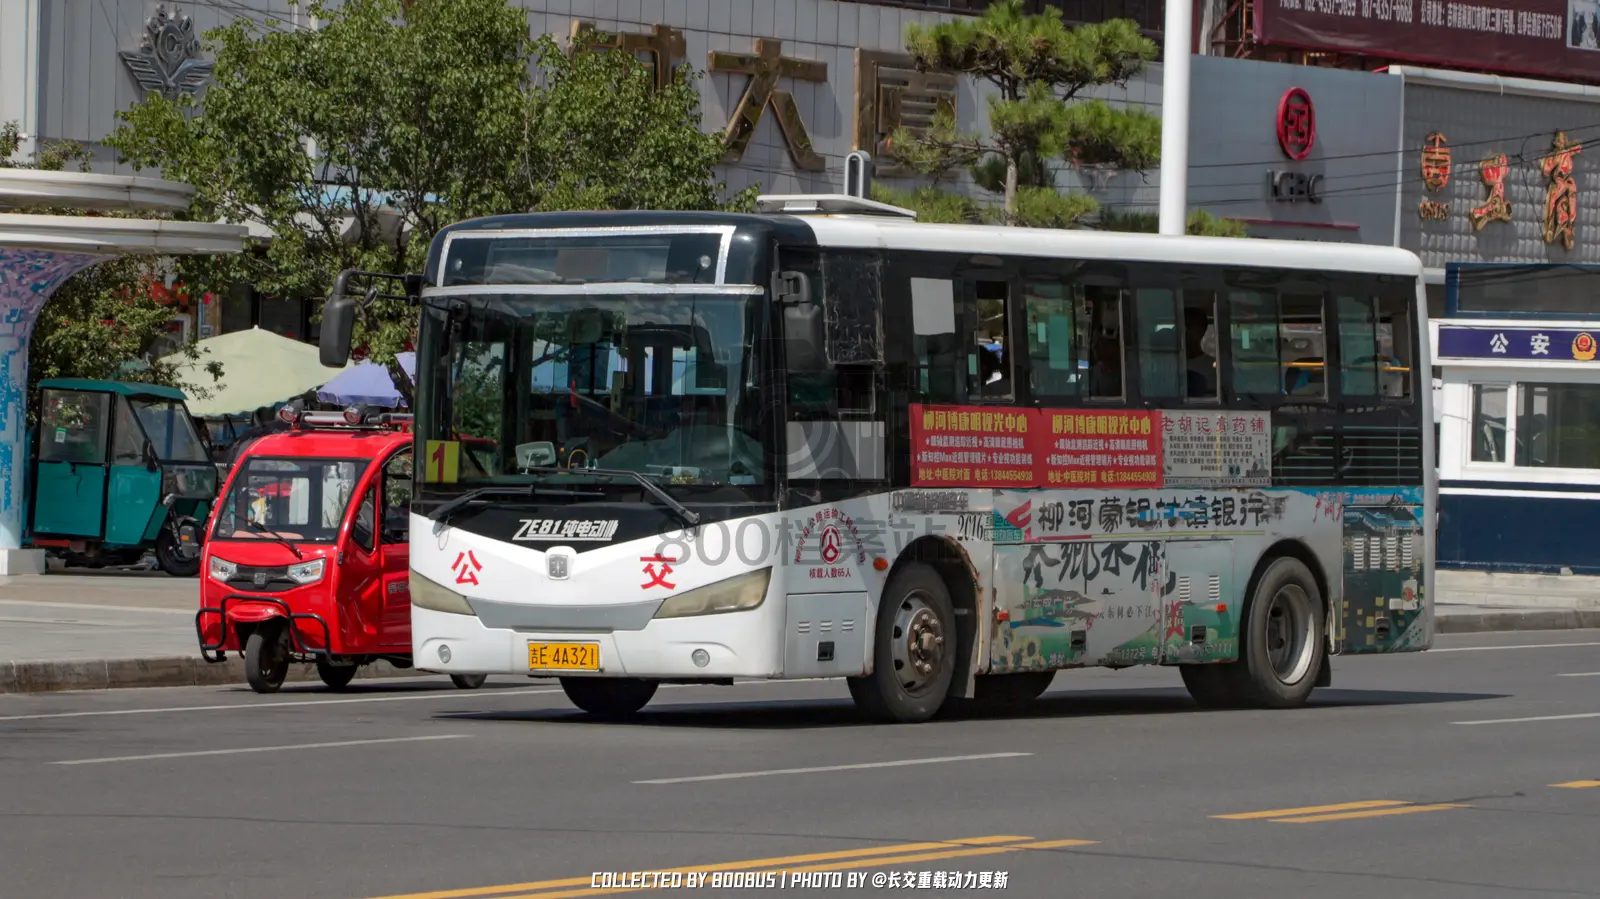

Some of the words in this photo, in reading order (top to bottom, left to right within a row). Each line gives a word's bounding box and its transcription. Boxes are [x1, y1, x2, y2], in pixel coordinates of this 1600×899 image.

[1490, 332, 1550, 355] 公安
[431, 443, 446, 483] 1
[451, 550, 482, 586] 公
[640, 553, 677, 589] 交
